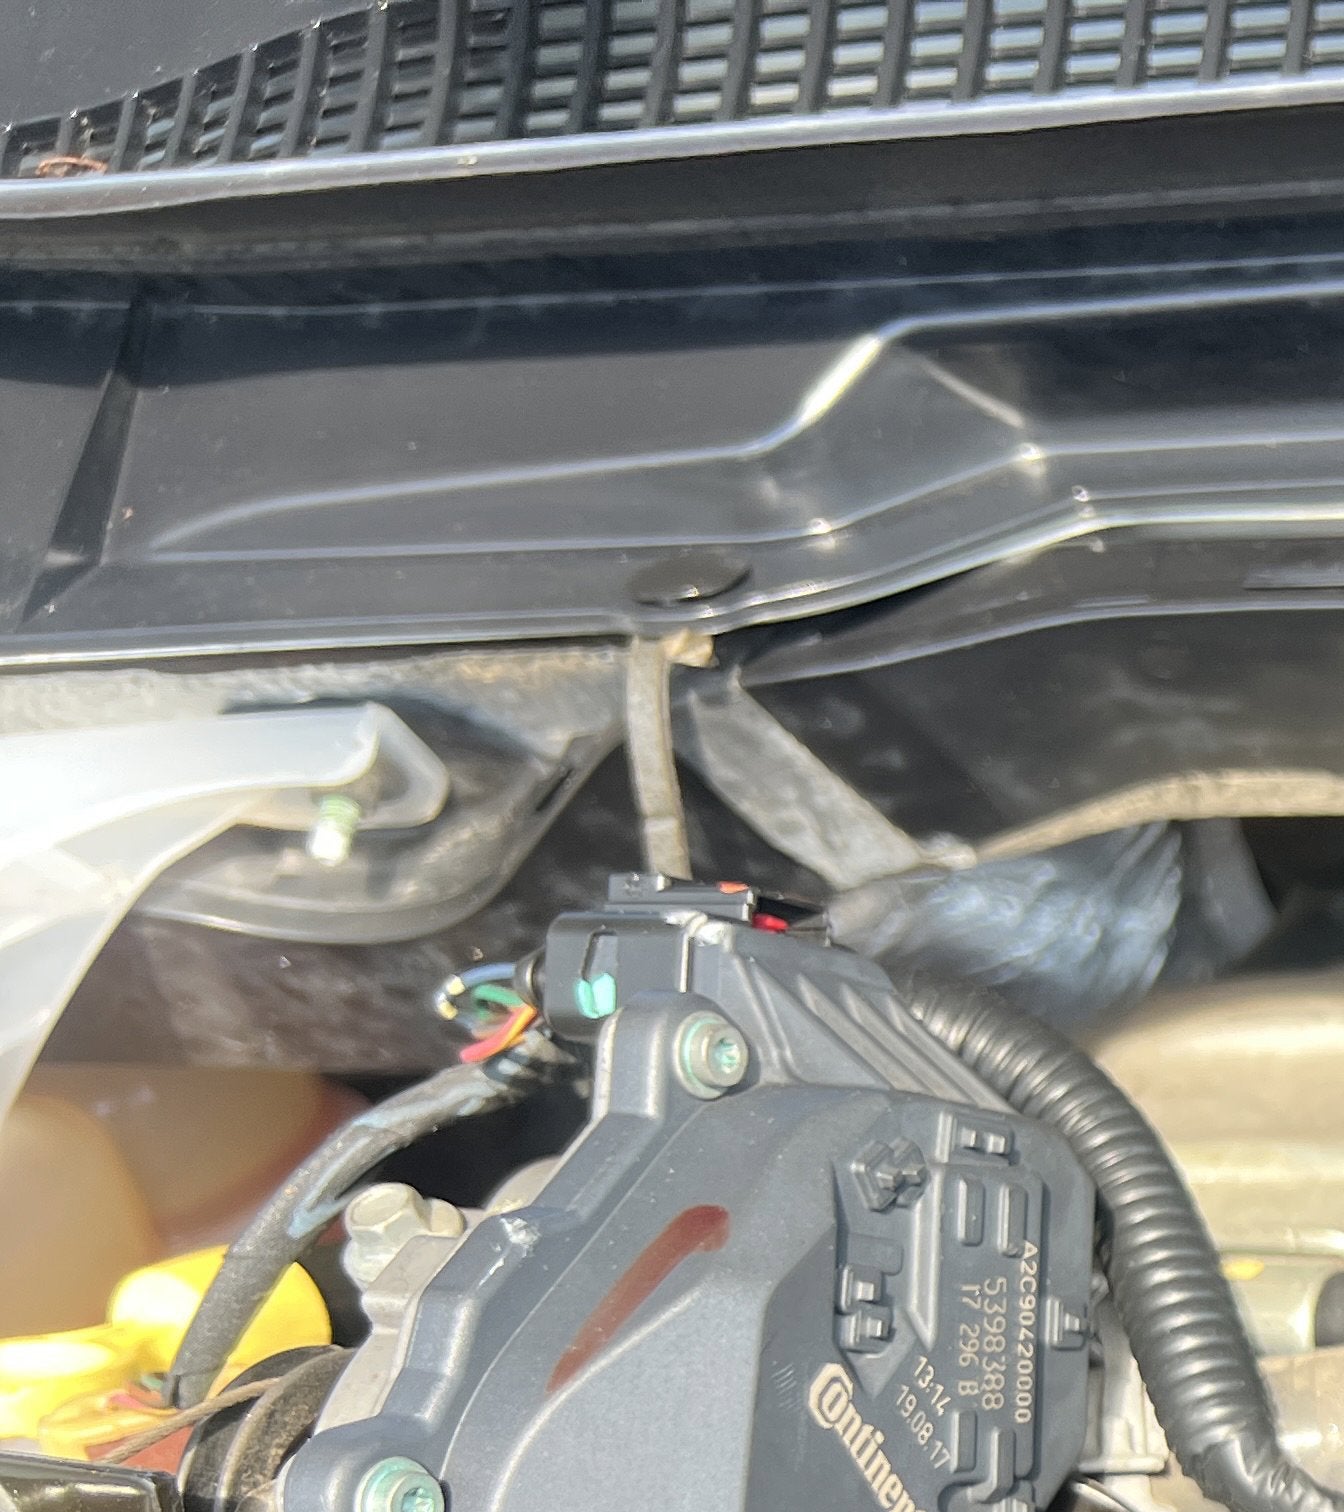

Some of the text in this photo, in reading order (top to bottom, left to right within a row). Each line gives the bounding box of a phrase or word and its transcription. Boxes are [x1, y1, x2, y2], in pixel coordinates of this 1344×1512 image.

[959, 1323, 980, 1367] 296
[982, 1277, 1007, 1410] 5398388
[1014, 1240, 1038, 1423] A2C90420000
[896, 1385, 950, 1469] 19.08.17
[914, 1356, 951, 1416] 13:14
